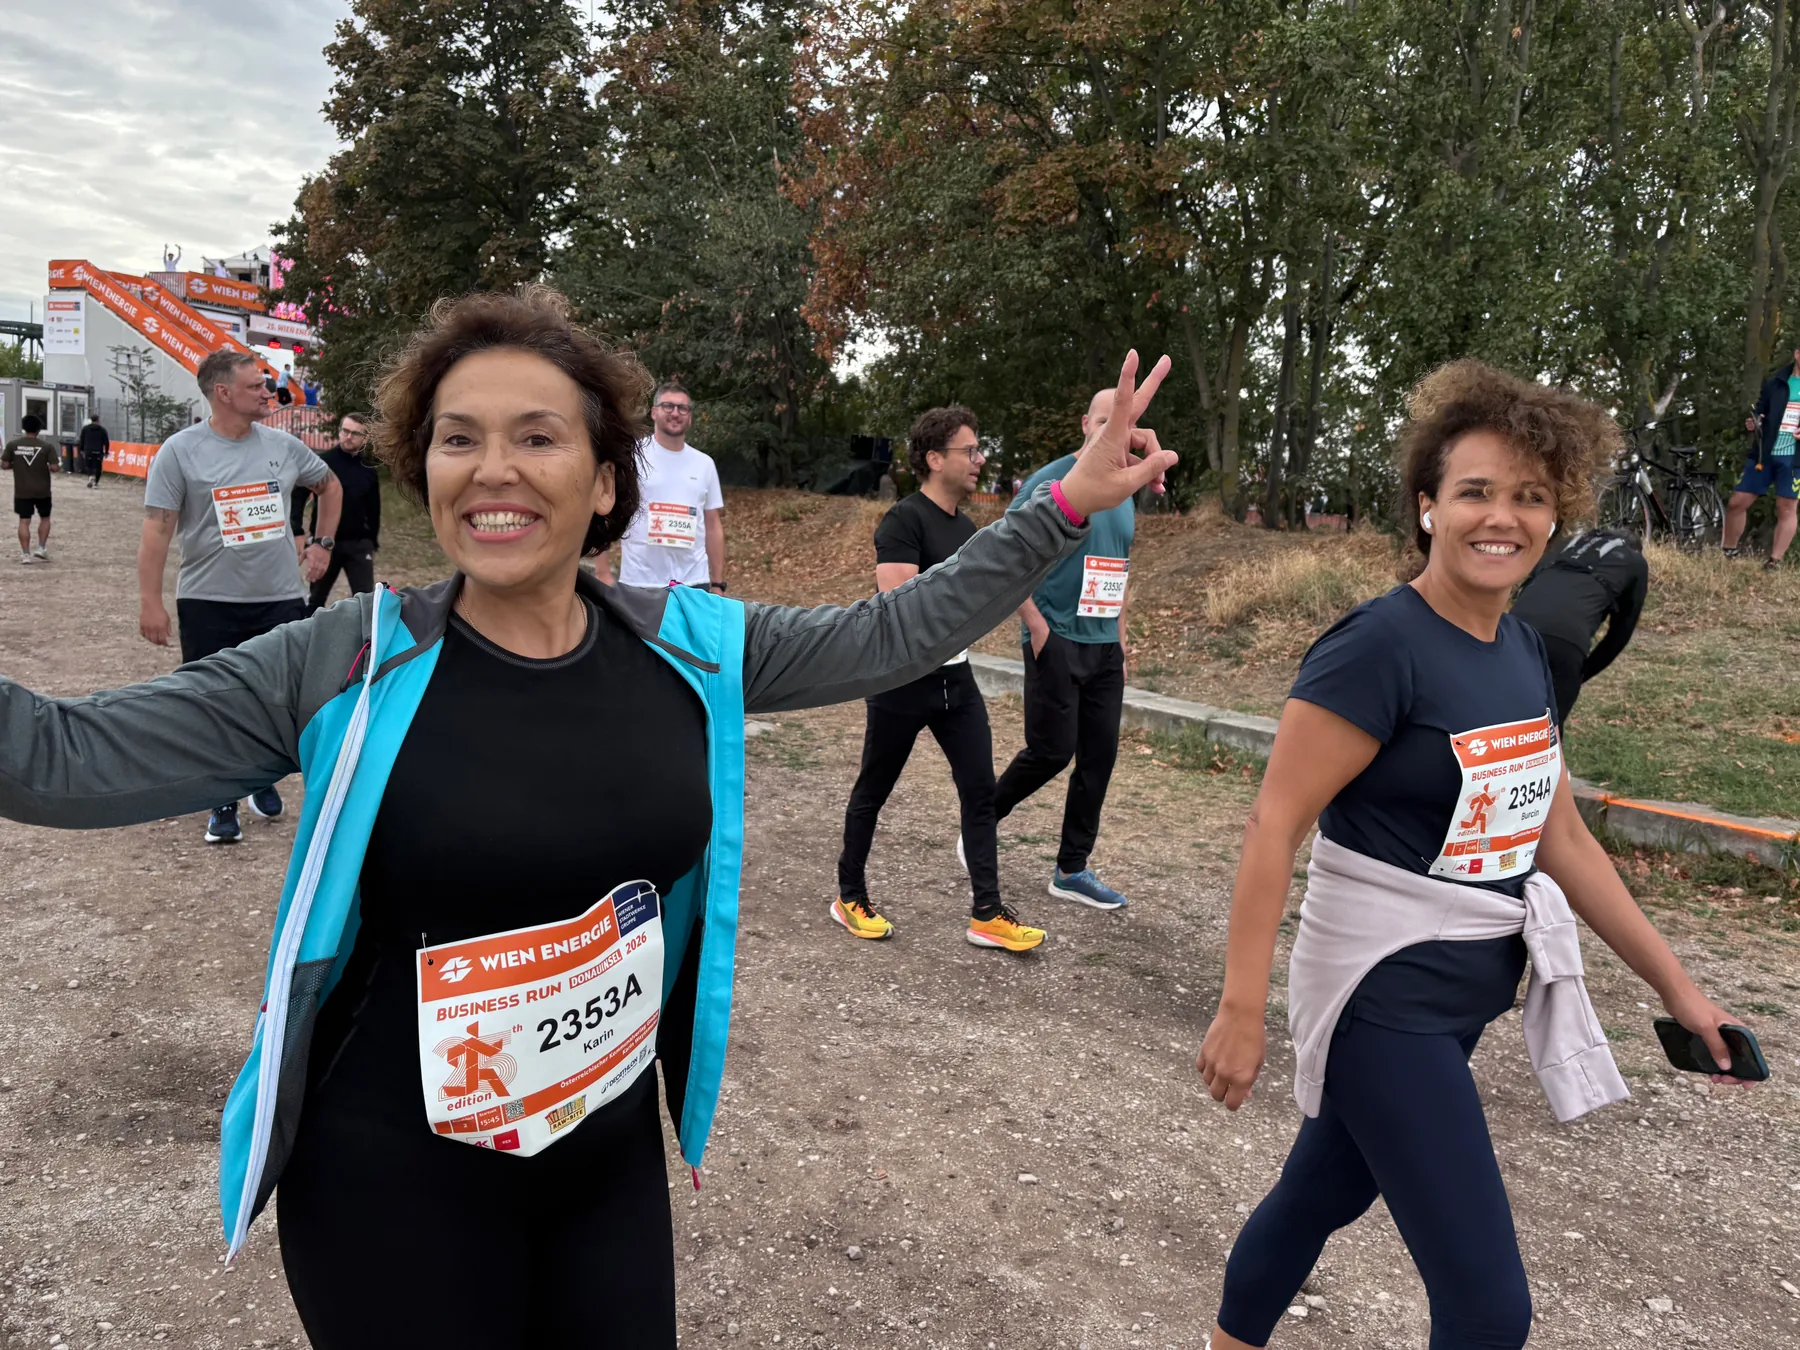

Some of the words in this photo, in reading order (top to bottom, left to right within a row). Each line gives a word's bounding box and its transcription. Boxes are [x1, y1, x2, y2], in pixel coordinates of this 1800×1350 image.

[82, 271, 107, 294] WIEN
[105, 290, 138, 318] ENERGIE
[212, 283, 240, 299] WIEN
[159, 295, 182, 319] WIEN
[180, 312, 216, 344] ENERGIE
[160, 328, 184, 353] WIEN
[247, 503, 278, 517] 2354C
[668, 520, 692, 529] 2355A
[1490, 735, 1517, 750] WIEN
[1518, 728, 1549, 744] ENERGIE
[1471, 765, 1508, 782] BUSINESS
[1508, 763, 1525, 774] RUN
[1507, 775, 1552, 811] 2354A
[1520, 809, 1540, 821] Burcin
[1457, 828, 1479, 837] edition
[1455, 863, 1468, 872] AK
[618, 904, 634, 917] WIENER
[619, 904, 647, 924] STADTWERKE
[620, 916, 637, 930] GRUPPE
[479, 946, 536, 973] WIEN
[540, 914, 613, 961] ENERGIE
[436, 993, 520, 1022] BUSINESS
[526, 981, 562, 1004] RUN
[570, 951, 622, 988] DONAUINSEL
[625, 931, 648, 955] 2026
[536, 972, 643, 1054] 2353A
[512, 1023, 523, 1034] th
[583, 1028, 614, 1054] Karin
[560, 1055, 609, 1088] Österreichischer
[446, 1091, 492, 1112] edition
[480, 1115, 500, 1127] 15:45
[551, 1109, 584, 1131] RAW-BITE
